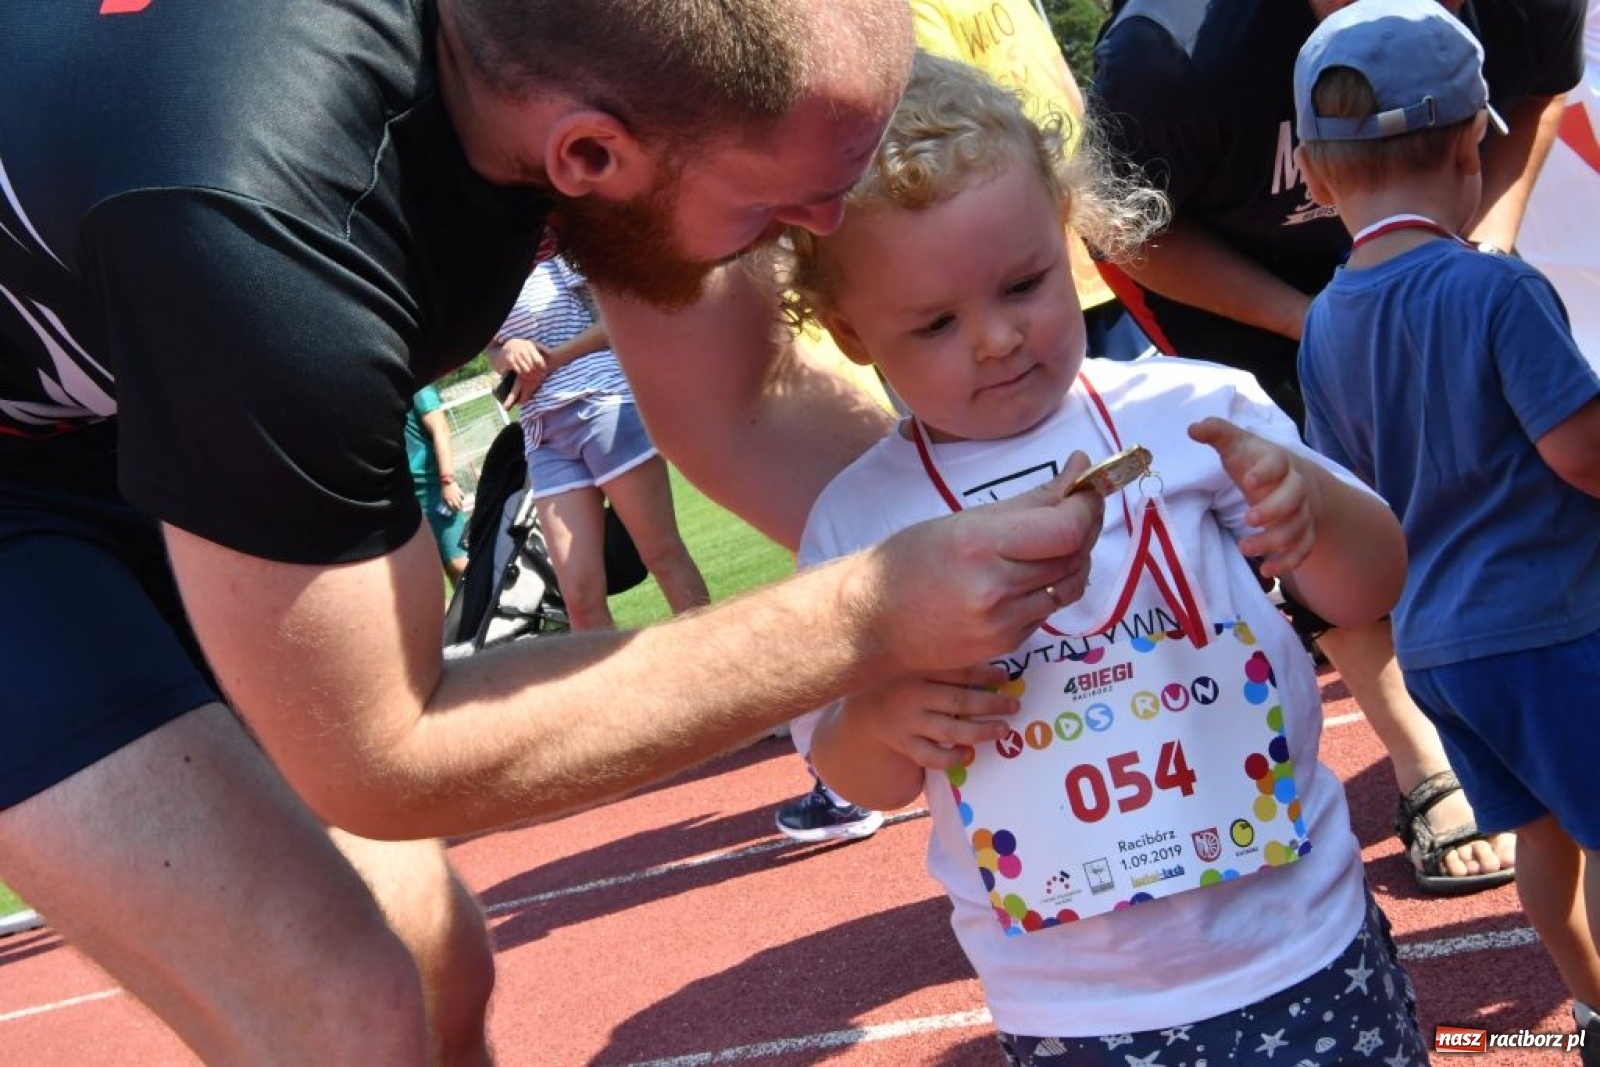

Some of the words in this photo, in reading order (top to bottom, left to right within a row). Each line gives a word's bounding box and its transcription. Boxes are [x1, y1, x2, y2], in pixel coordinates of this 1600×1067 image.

[997, 703, 1114, 759] KIDS
[1131, 676, 1219, 720] RUN
[1065, 739, 1197, 823] 054
[1117, 830, 1176, 853] Racibórz
[1120, 844, 1182, 871] 1.09.2019
